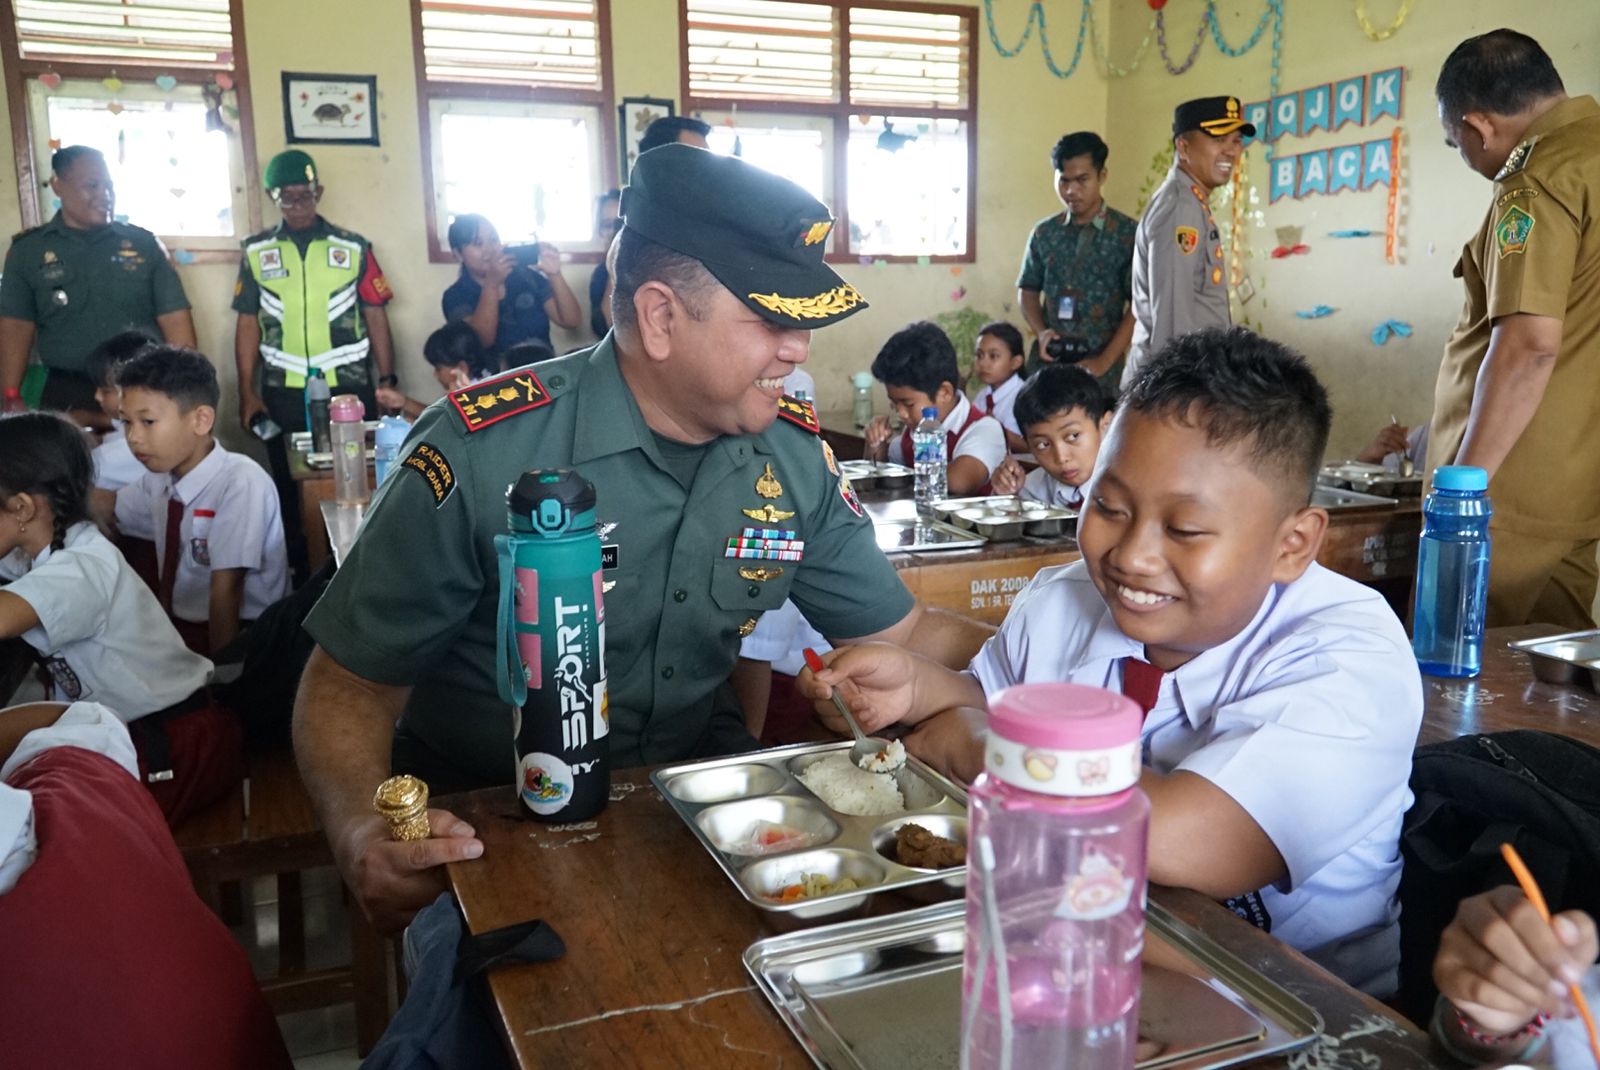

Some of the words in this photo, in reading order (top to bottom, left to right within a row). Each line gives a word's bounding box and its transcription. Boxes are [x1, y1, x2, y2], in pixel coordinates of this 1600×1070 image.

[1251, 74, 1396, 128] POJOK
[1277, 144, 1390, 187] BACA
[417, 445, 452, 487] RAIDER
[971, 579, 997, 594] DAK
